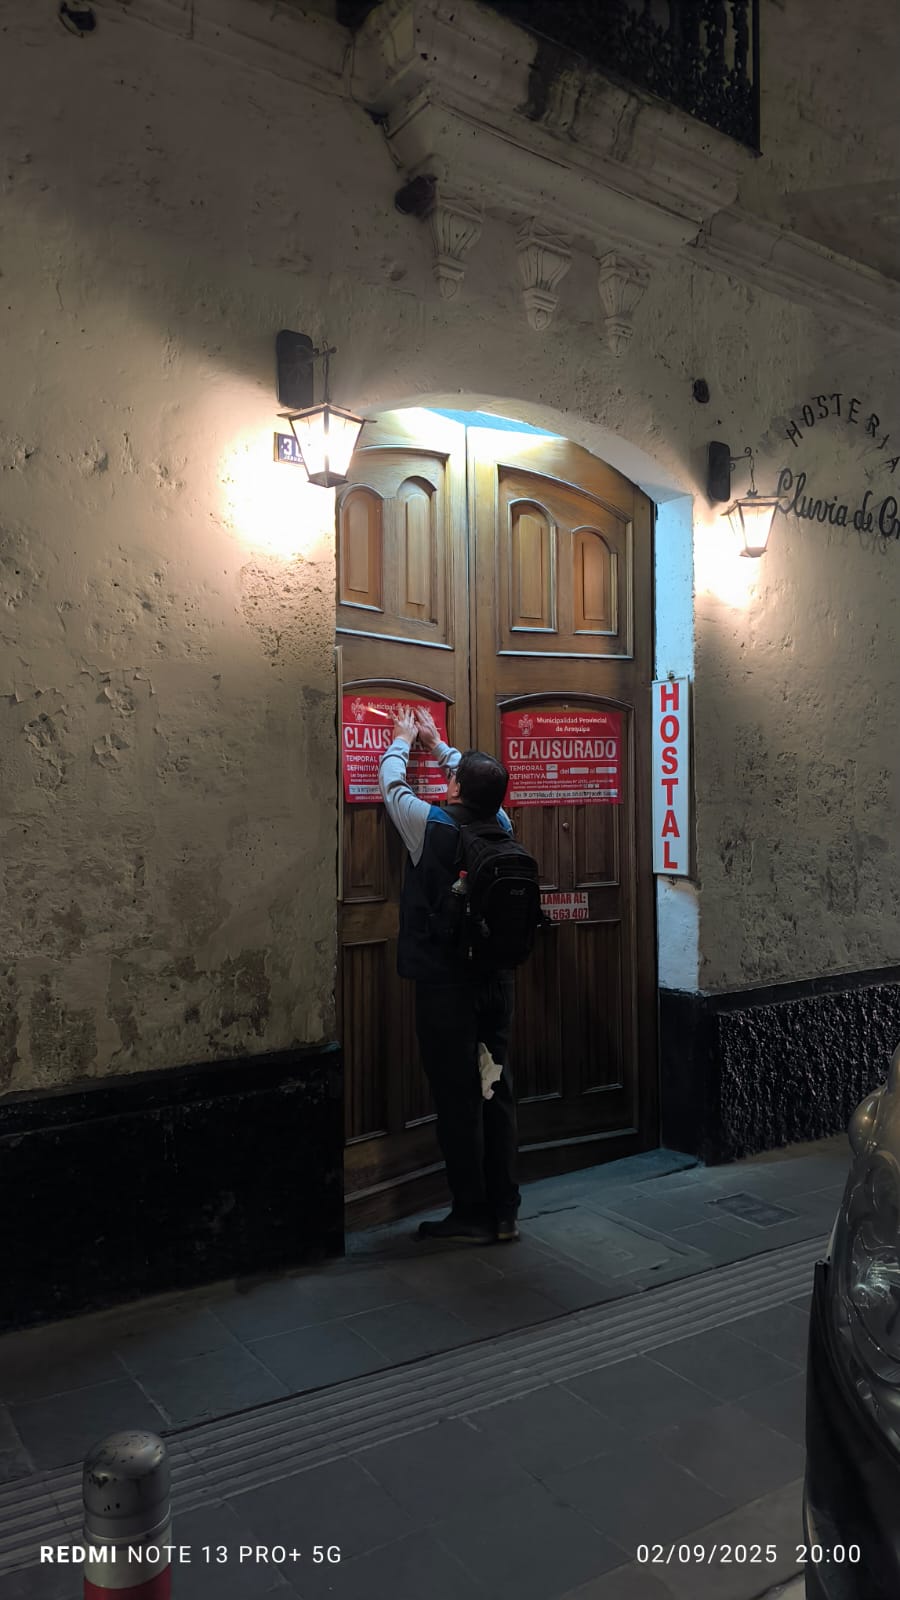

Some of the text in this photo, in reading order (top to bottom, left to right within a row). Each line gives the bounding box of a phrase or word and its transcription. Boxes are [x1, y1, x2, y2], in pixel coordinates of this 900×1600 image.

[786, 394, 900, 473] HOSTERIA
[853, 490, 874, 533] de
[565, 725, 590, 733] Arequipa
[508, 740, 616, 759] CLAUSURADO
[660, 683, 680, 870] HOSTAL
[542, 894, 571, 904] LAMAR
